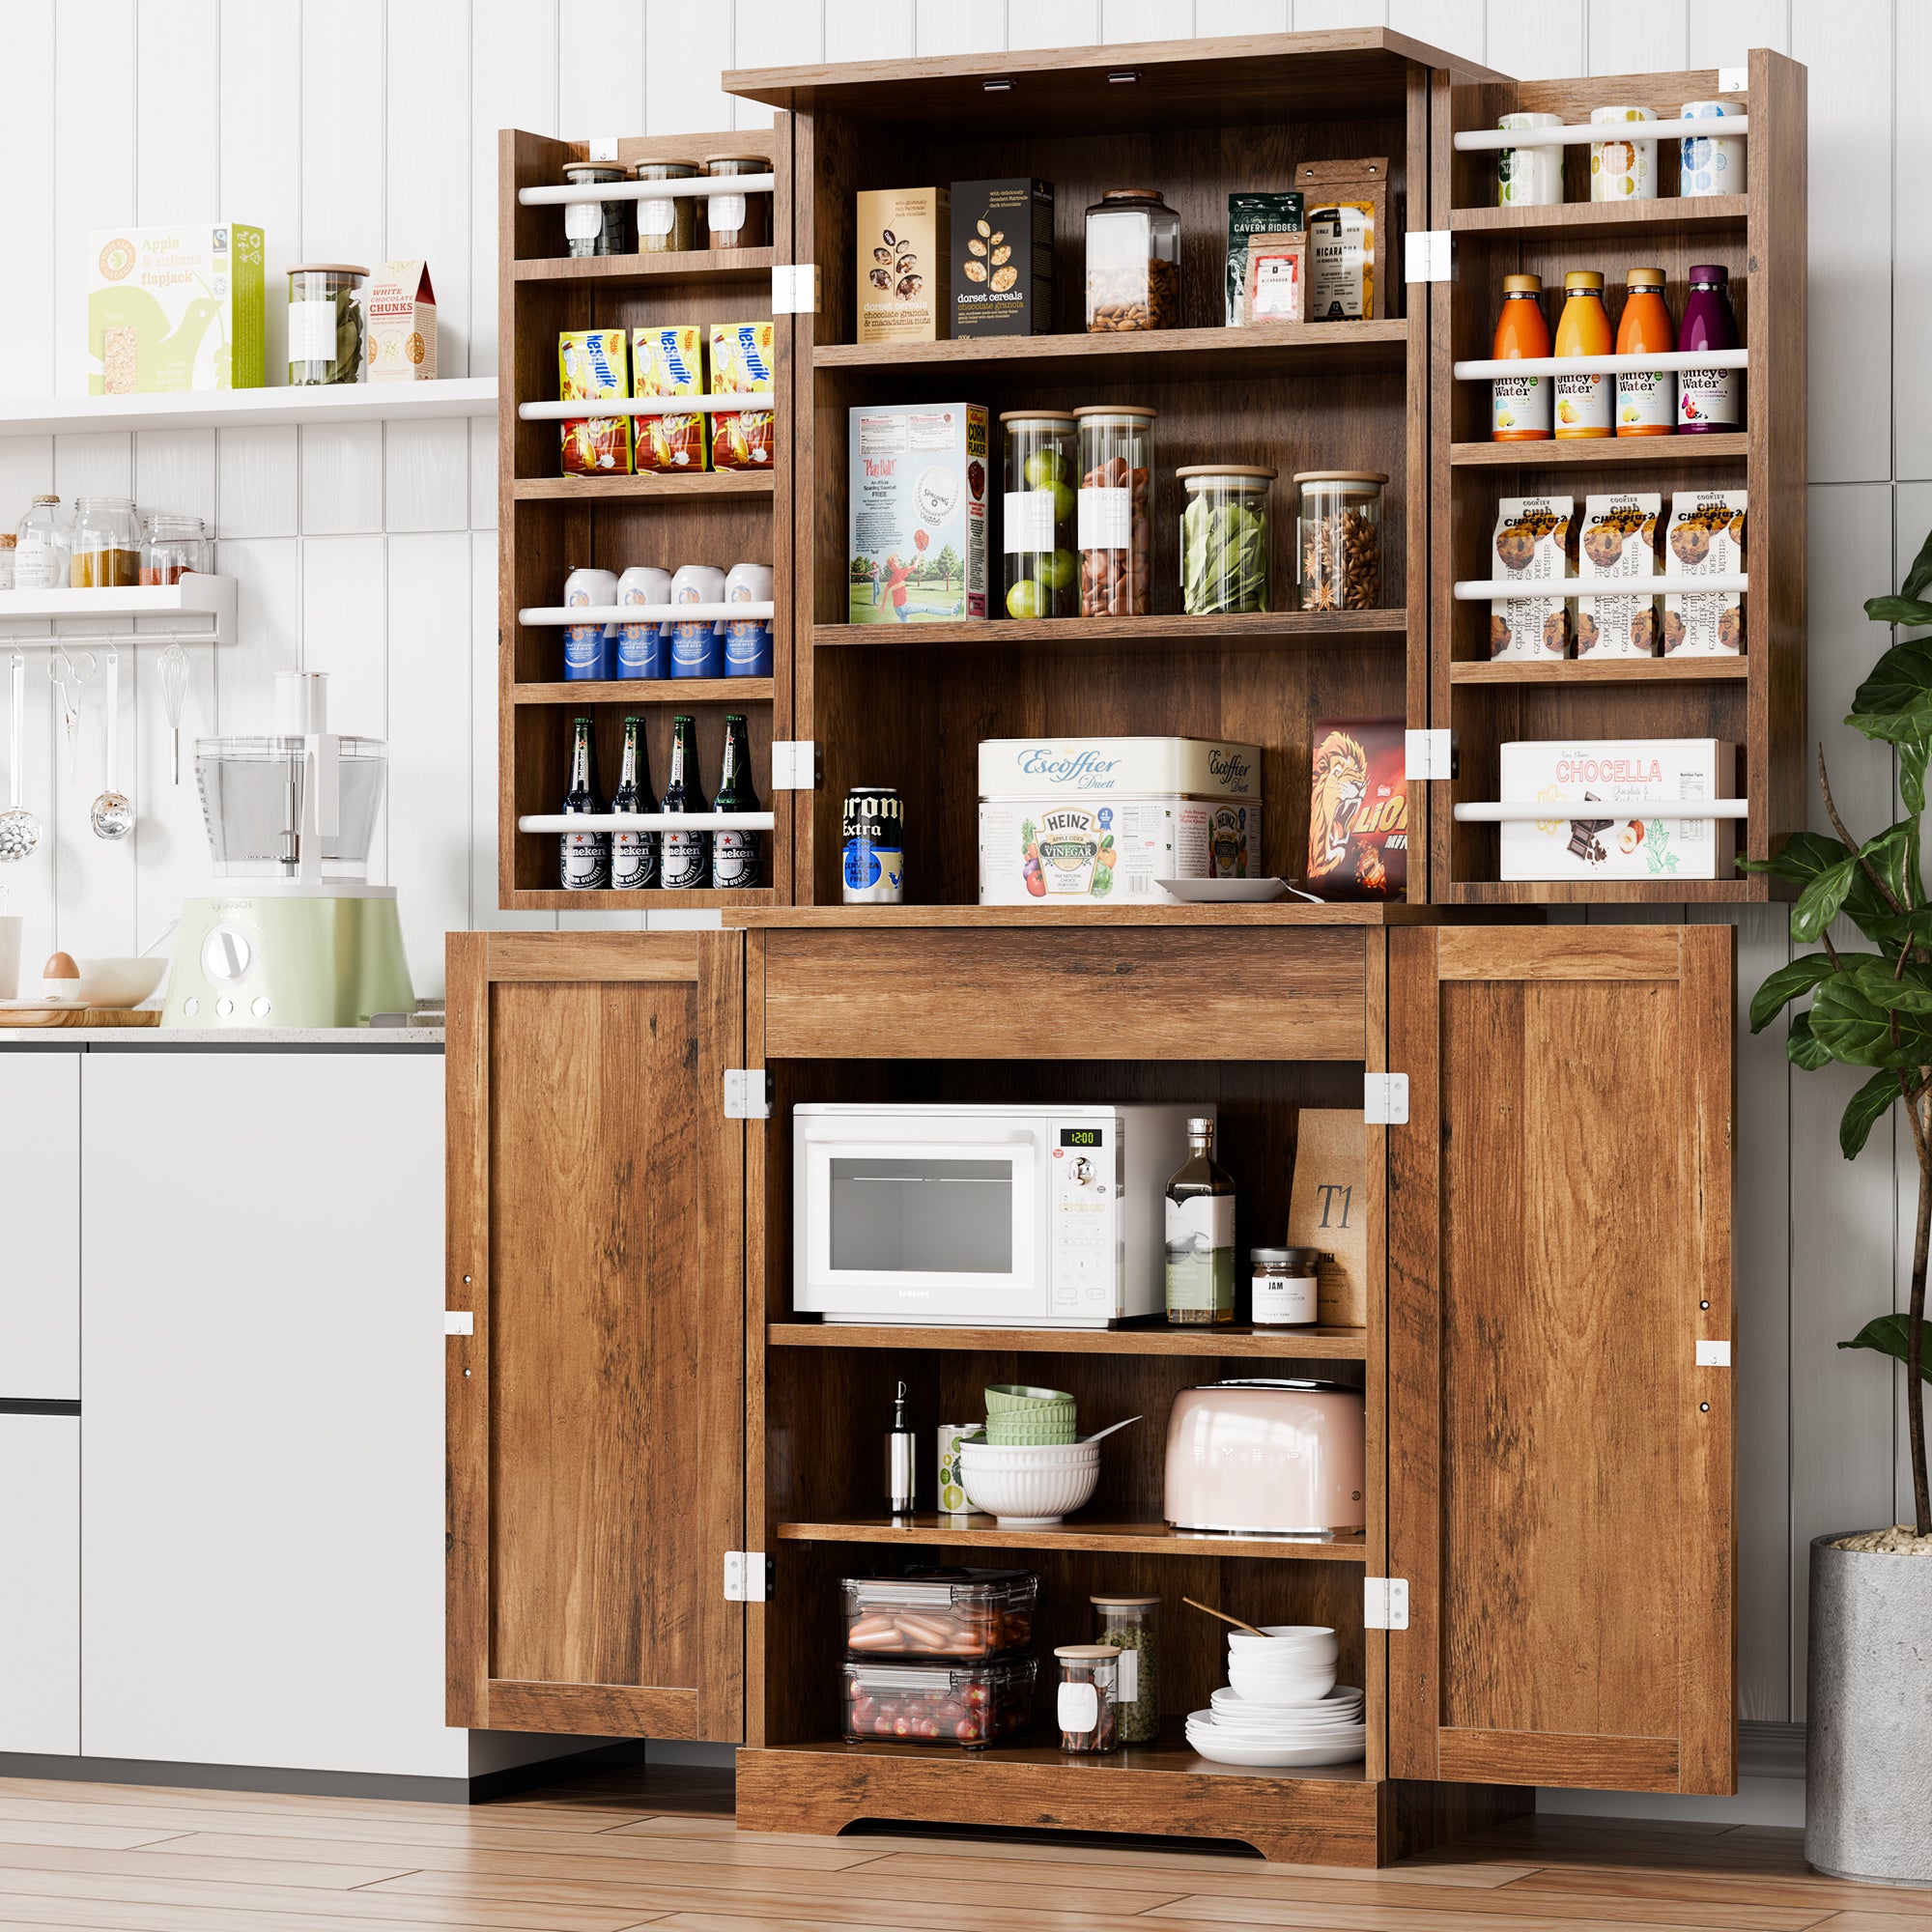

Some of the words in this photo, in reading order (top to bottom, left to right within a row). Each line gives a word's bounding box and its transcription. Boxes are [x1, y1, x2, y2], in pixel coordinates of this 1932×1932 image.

[1234, 223, 1266, 233] CAVERN
[1268, 222, 1297, 232] RIDGES
[141, 237, 180, 252] Apple
[142, 256, 152, 268] &
[156, 254, 202, 267] sultana
[141, 270, 193, 287] flapjack
[957, 294, 987, 303] dorset
[989, 291, 1023, 301] cereals
[369, 302, 413, 313] CHUNKS
[864, 301, 893, 312] dorset
[895, 300, 928, 310] cereals
[958, 302, 994, 311] chocolate
[995, 300, 1024, 310] granola
[864, 311, 899, 320] chocolate
[900, 309, 929, 318] granola
[914, 317, 931, 326] nuts
[586, 334, 617, 387] Nesquik
[660, 331, 693, 384] Nesquik
[737, 327, 771, 382] Nesquik
[1557, 374, 1592, 384] Juicy
[1620, 371, 1654, 382] Juicy
[1684, 369, 1718, 380] Juicy
[1495, 377, 1529, 387] Juicy
[1619, 381, 1656, 391] Water
[1683, 379, 1719, 389] Water
[1494, 387, 1531, 397] Water
[1557, 384, 1593, 394] Water
[968, 423, 986, 443] CORN
[968, 441, 986, 455] FLAKES
[1089, 493, 1129, 502] APRICO
[1017, 749, 1122, 783] Escoffier
[1208, 750, 1251, 784] Escoffier
[1555, 759, 1662, 783] CHOCELLA
[1077, 774, 1116, 789] Duett
[1047, 813, 1090, 831] HEINZ
[1217, 812, 1236, 831] HEINZ
[1044, 847, 1092, 857] VINEGAR
[581, 866, 602, 883] QUALITY
[625, 865, 646, 882] QUALITY
[675, 865, 697, 882] QUALITY
[728, 867, 751, 885] QUALITY
[1071, 1132, 1094, 1144] 12:00
[1317, 1184, 1352, 1229] T1
[1323, 1252, 1335, 1264] TEA
[1268, 1282, 1284, 1291] JAM
[1193, 1445, 1299, 1459] SMEG
